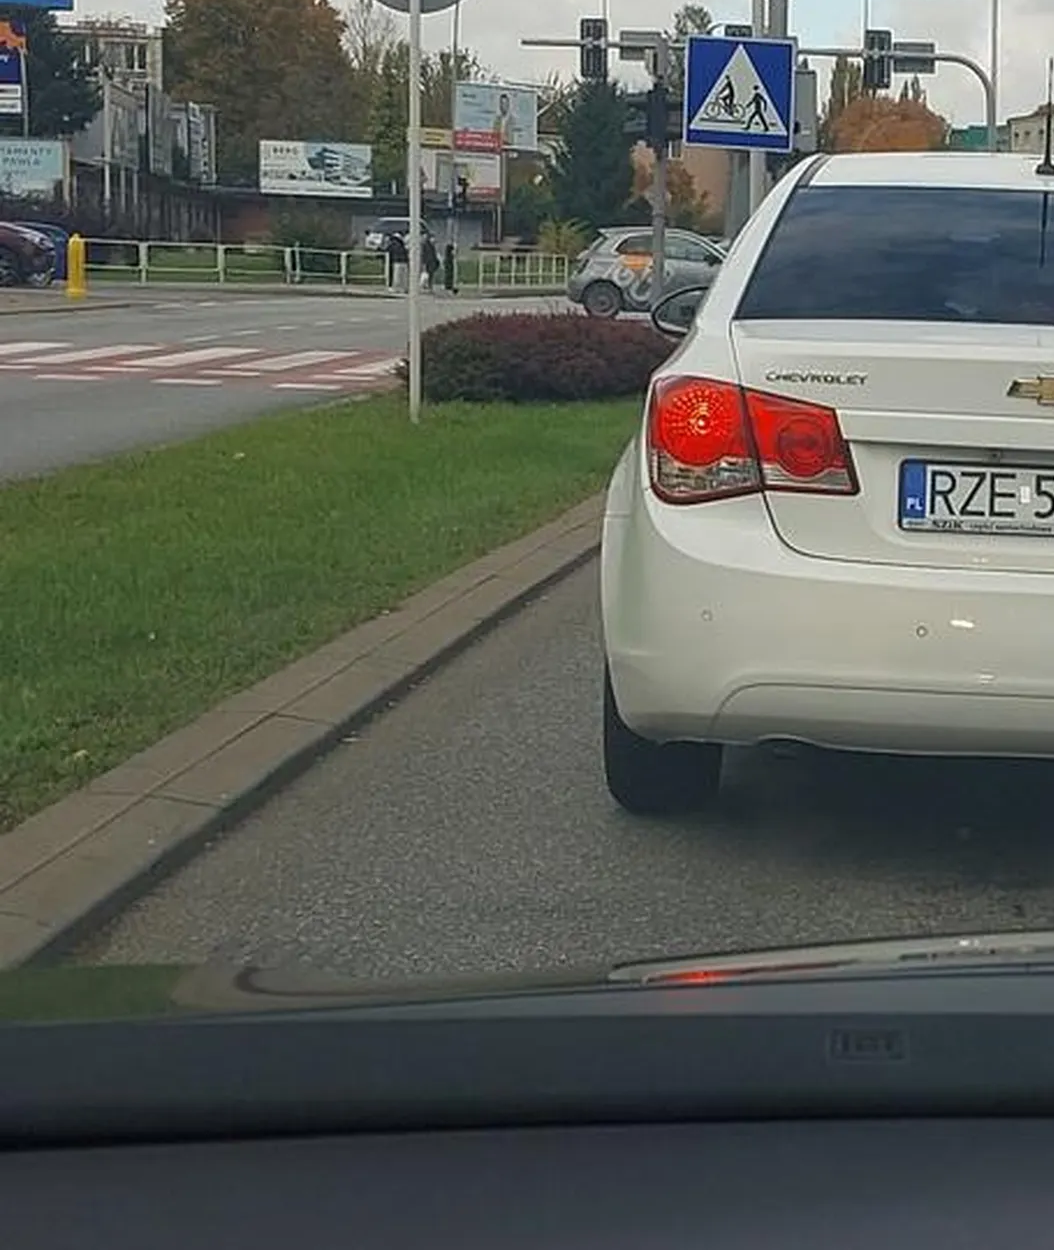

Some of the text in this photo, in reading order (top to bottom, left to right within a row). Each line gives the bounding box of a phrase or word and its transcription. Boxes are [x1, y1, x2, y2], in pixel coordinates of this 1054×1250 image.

[765, 371, 868, 385] CHEVROLET
[929, 469, 1017, 517] RZE
[906, 498, 924, 511] PL
